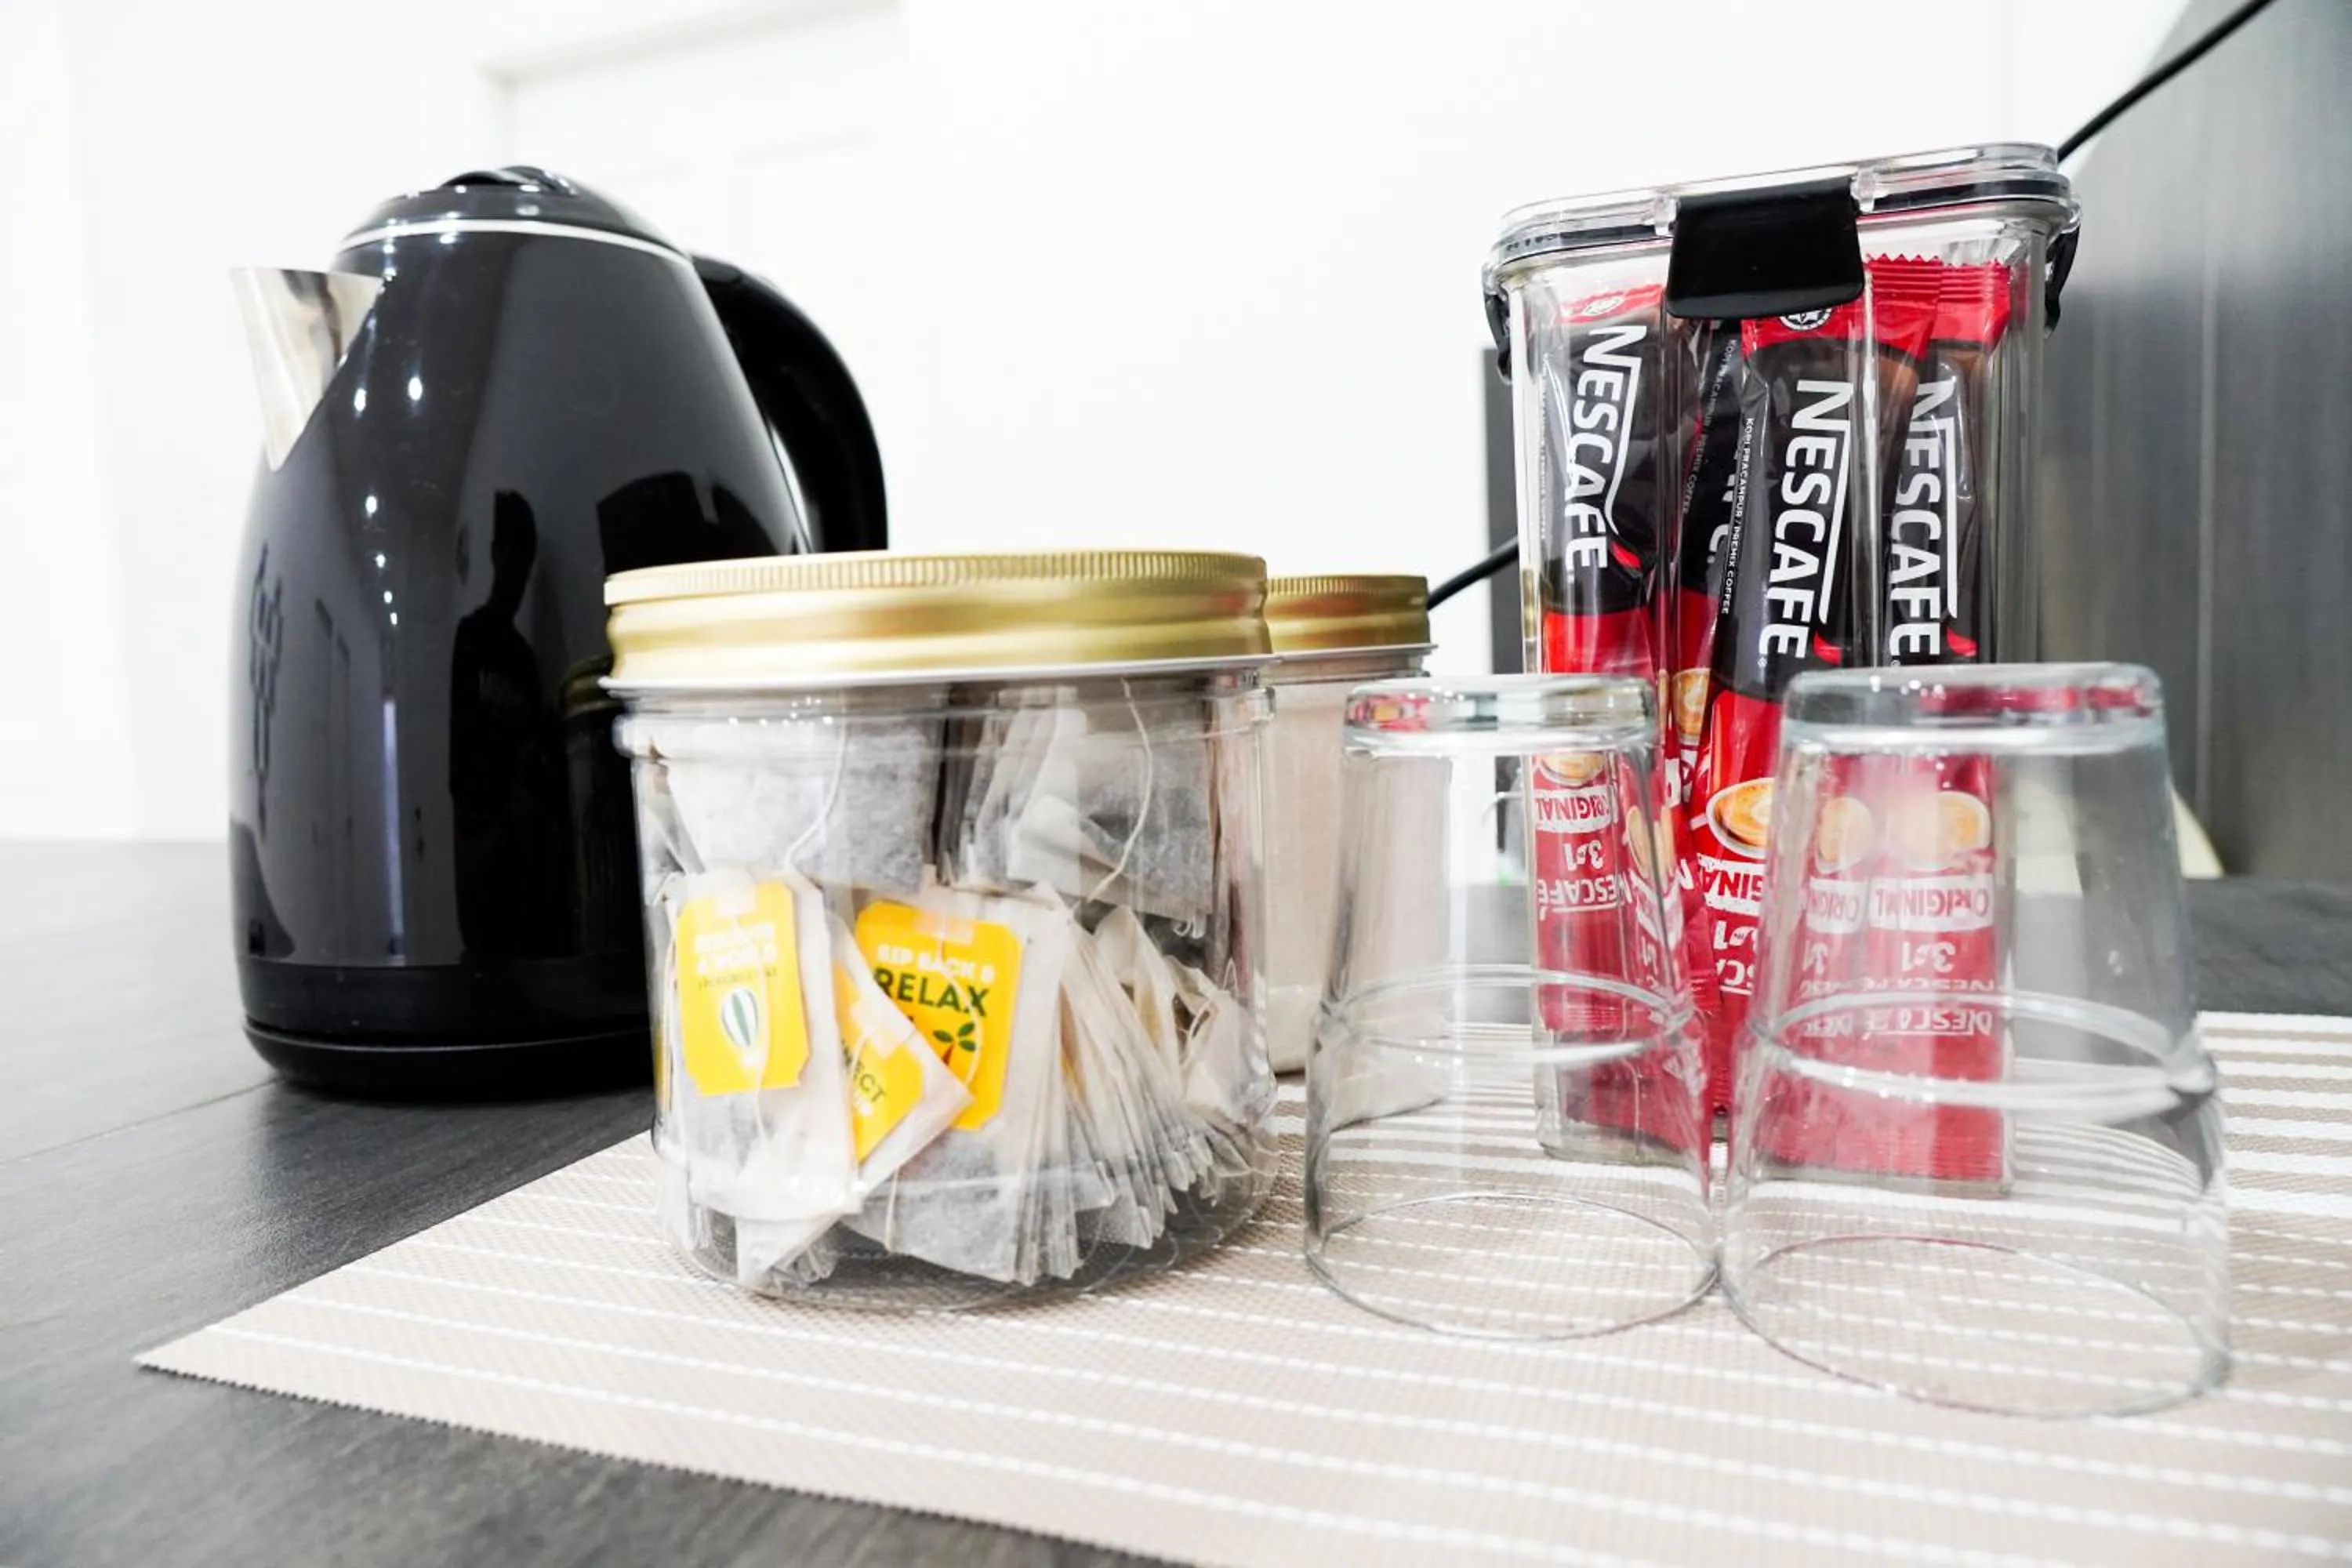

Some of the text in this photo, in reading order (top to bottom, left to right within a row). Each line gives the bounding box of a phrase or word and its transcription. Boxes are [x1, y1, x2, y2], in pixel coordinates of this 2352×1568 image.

[1743, 418, 1755, 445] KOPI
[1735, 448, 1751, 517] PRACAMPUR
[1729, 525, 1741, 567] PREMIX
[1722, 570, 1734, 615] COFFEE
[873, 966, 990, 1018] RELAX
